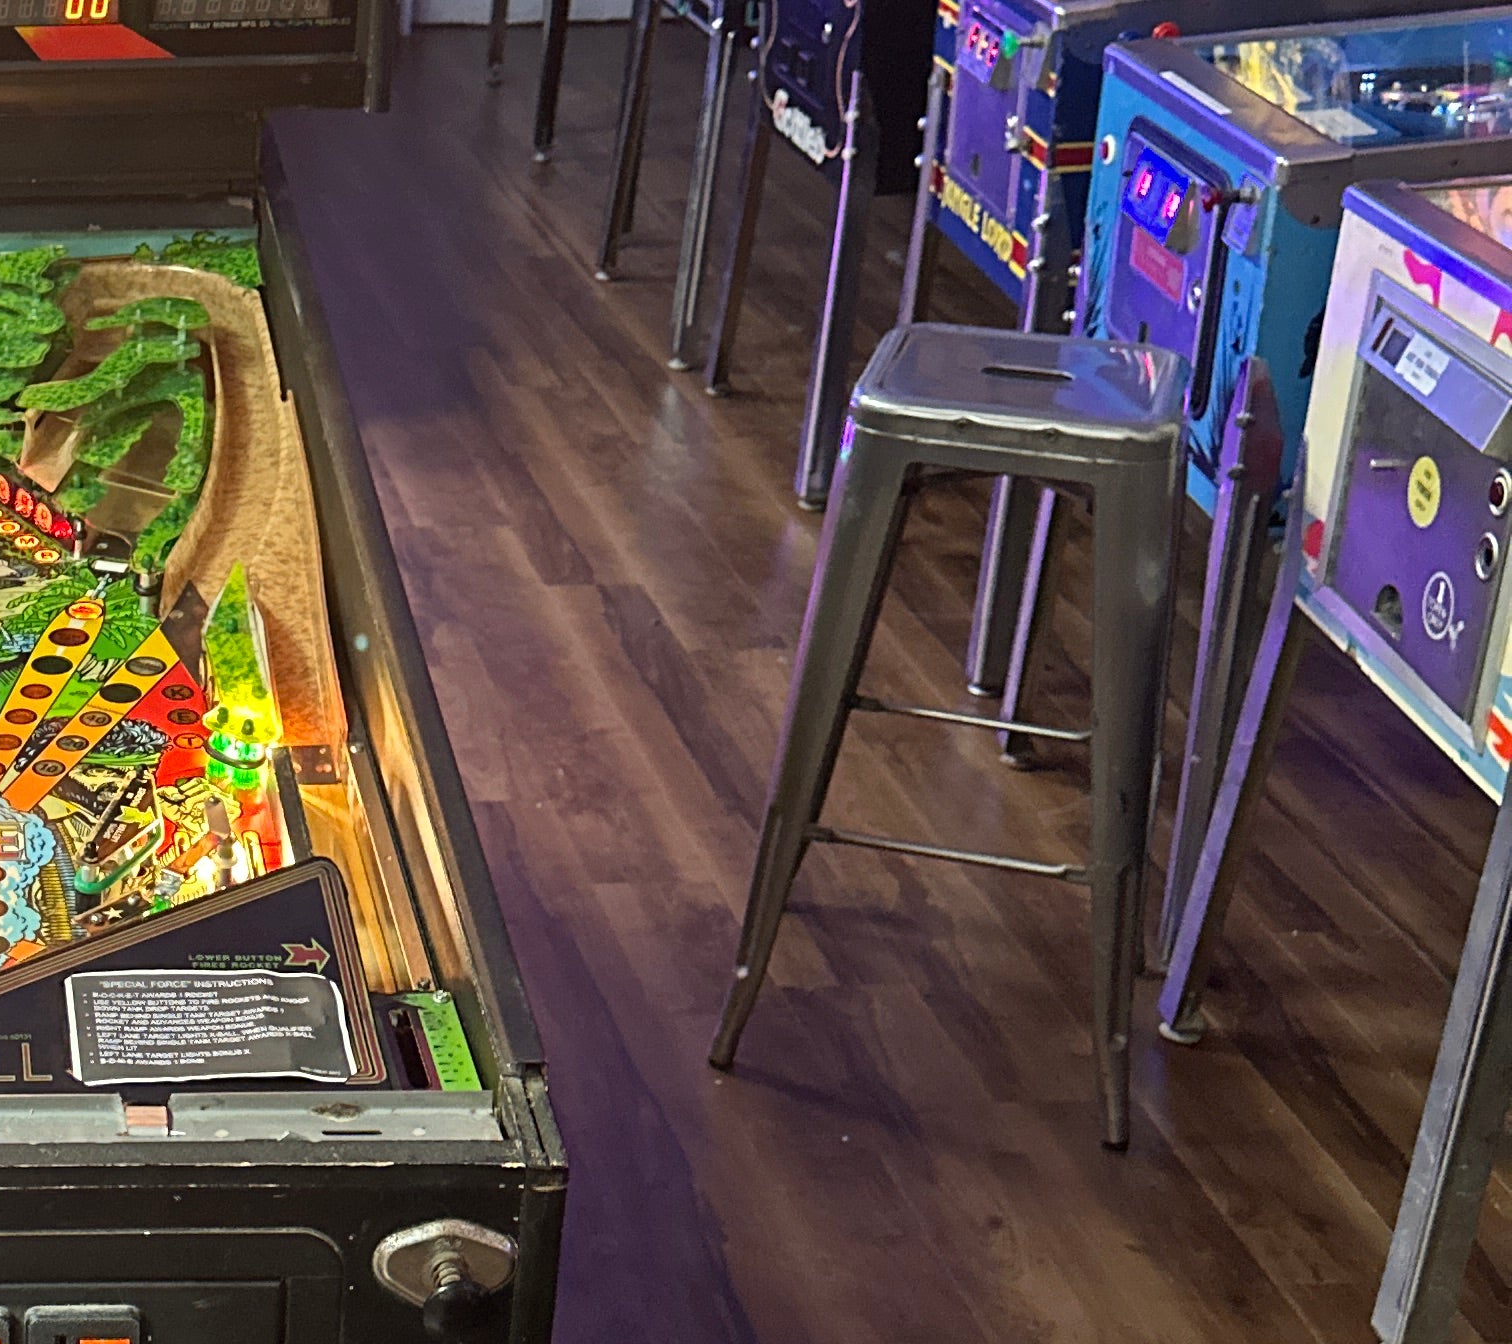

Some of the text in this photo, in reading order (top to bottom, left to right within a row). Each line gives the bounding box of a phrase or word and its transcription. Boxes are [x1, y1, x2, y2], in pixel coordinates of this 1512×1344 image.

[188, 954, 282, 962] LOWER BUTTON
[194, 979, 273, 987] INSTRUCTIONS
[221, 995, 261, 1004] ROCKETS
